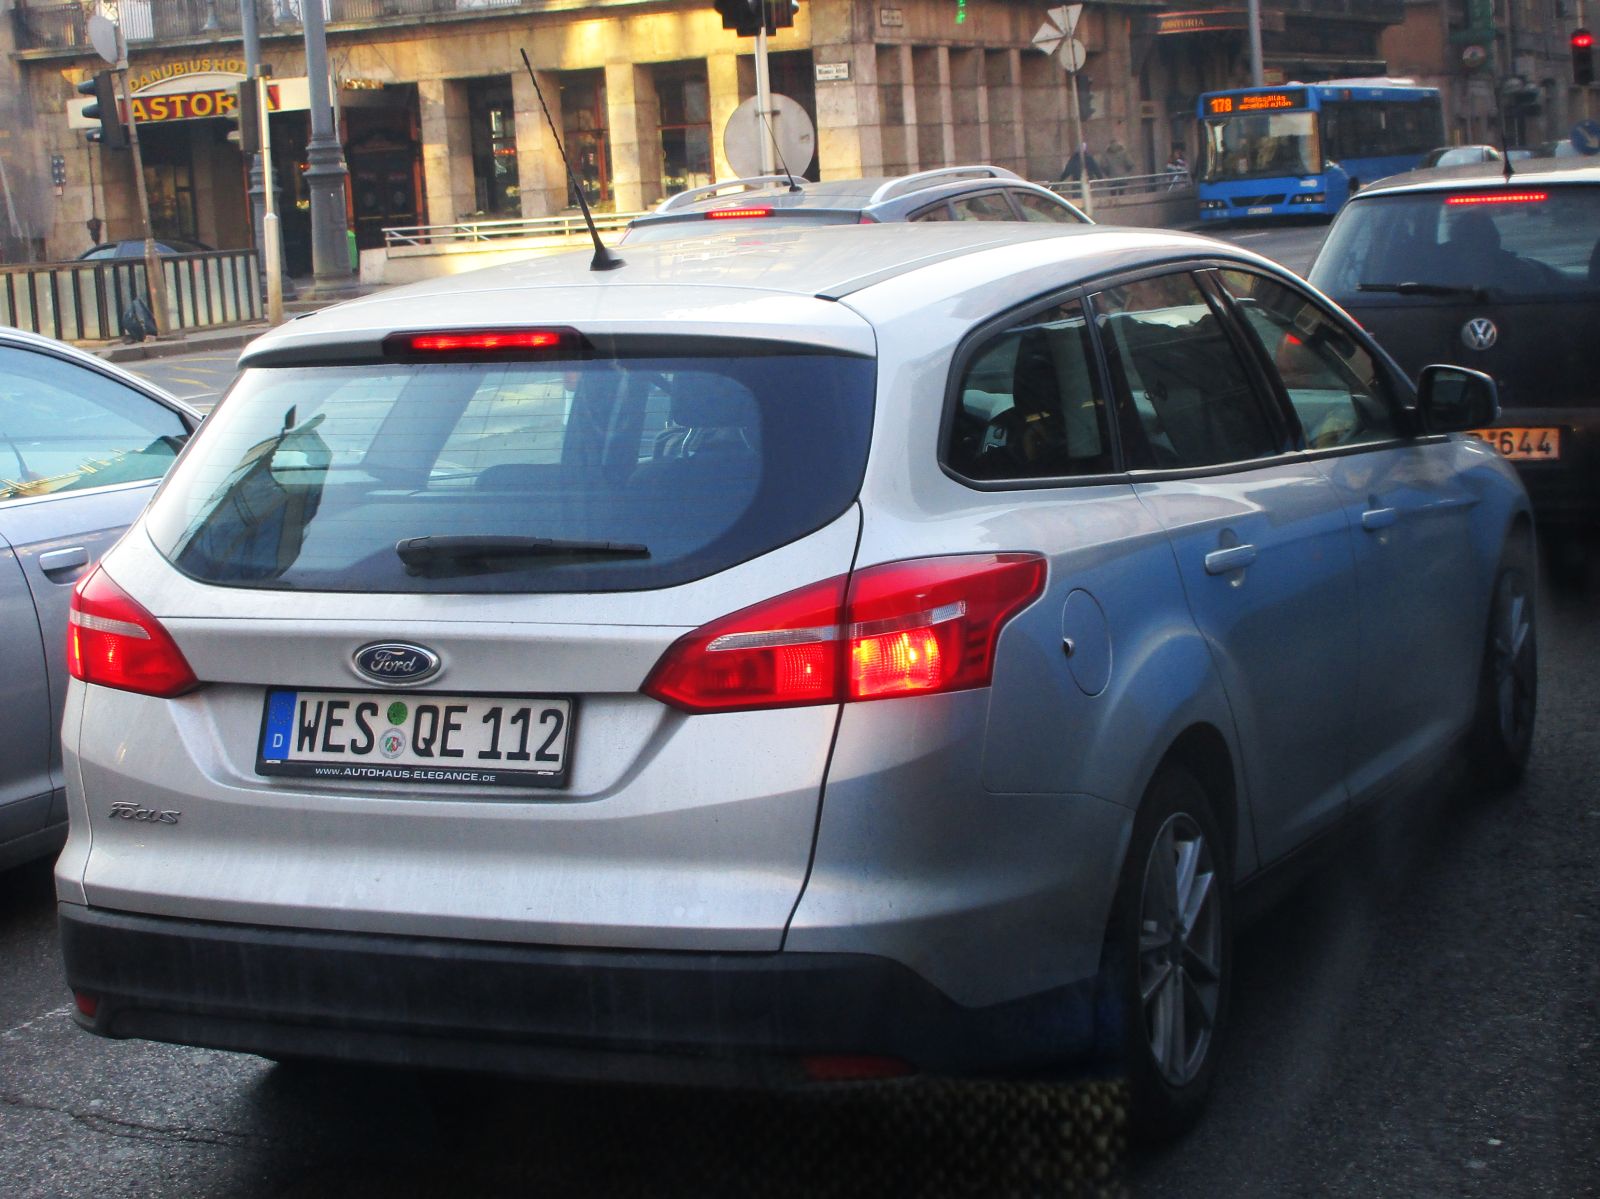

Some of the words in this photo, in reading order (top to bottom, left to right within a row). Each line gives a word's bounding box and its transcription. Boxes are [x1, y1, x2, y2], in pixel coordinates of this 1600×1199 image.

[128, 59, 212, 92] DANUBIUS
[131, 91, 275, 121] ASTOR
[1211, 98, 1233, 113] 178
[371, 650, 417, 672] Ford
[272, 733, 283, 748] D
[297, 700, 379, 755] WES
[411, 705, 468, 758] QE
[478, 707, 565, 762] 112
